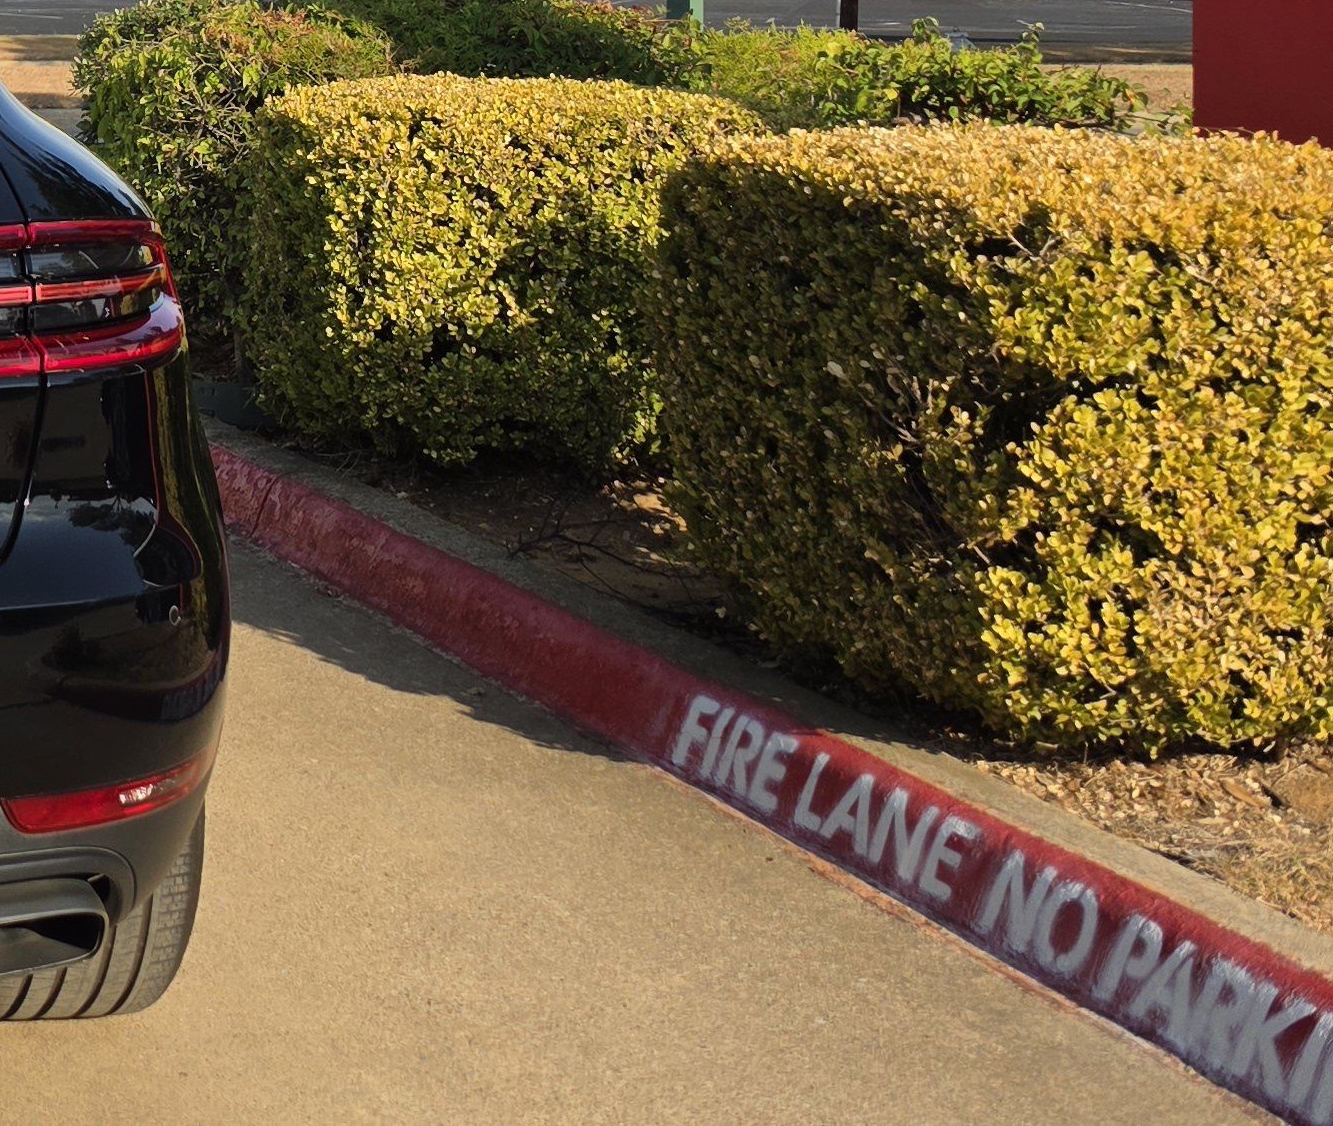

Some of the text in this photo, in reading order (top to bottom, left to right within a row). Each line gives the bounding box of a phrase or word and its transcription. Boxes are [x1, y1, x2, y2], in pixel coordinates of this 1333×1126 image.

[671, 693, 800, 817] FIRE
[793, 751, 983, 904] LANE
[974, 847, 1102, 973] NO
